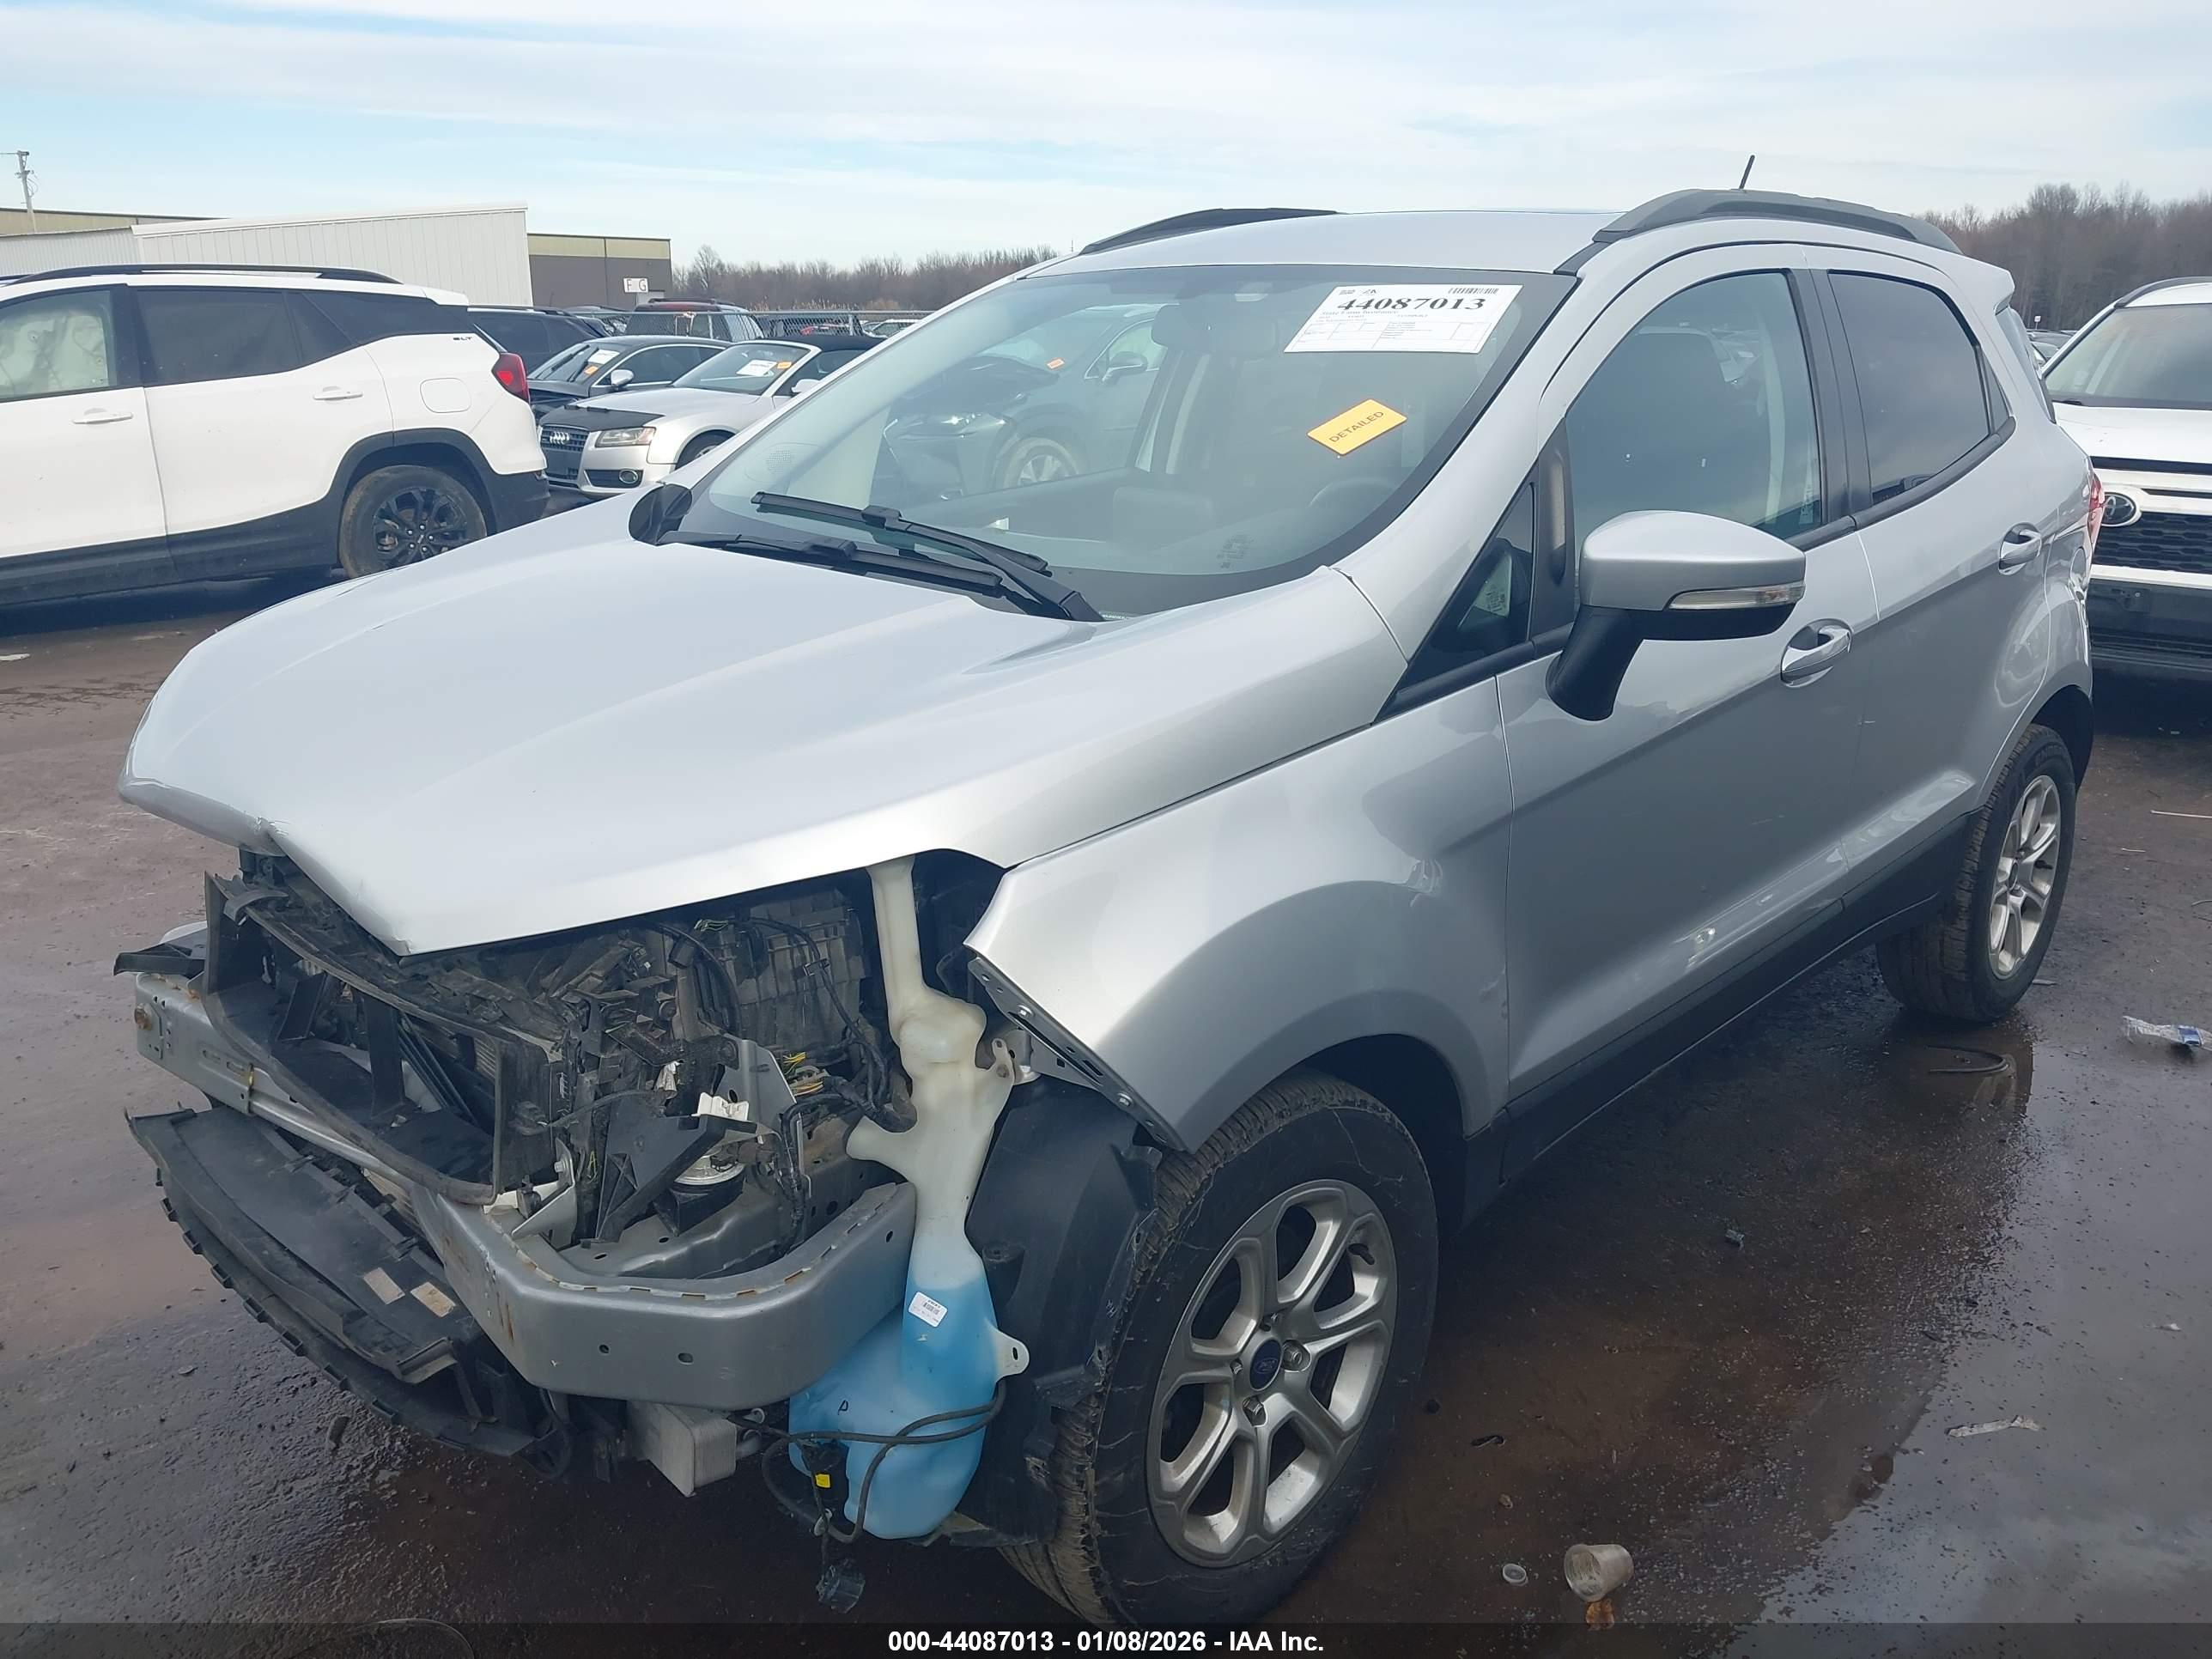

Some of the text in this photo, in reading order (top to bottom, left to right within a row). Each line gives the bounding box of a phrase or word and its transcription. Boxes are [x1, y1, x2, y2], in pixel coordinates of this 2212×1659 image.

[626, 278, 647, 292] F G
[1337, 297, 1486, 310] 44087013
[1328, 411, 1384, 443] DETAILED
